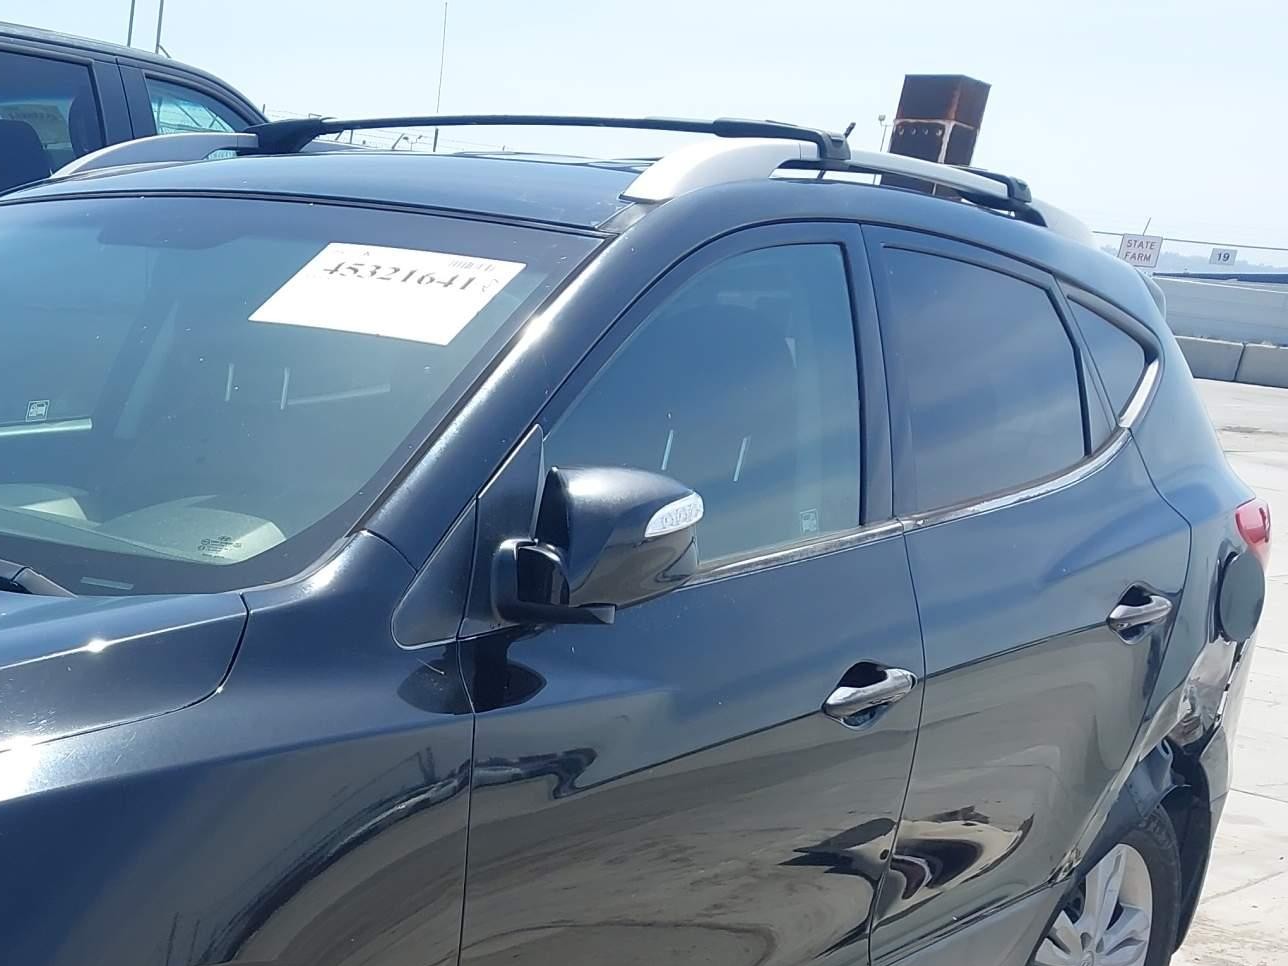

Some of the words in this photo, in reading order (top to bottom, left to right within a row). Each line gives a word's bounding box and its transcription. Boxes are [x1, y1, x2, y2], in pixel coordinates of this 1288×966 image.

[1126, 239, 1156, 250] STATE
[1123, 251, 1152, 262] FARM
[1217, 252, 1230, 262] 19
[323, 261, 476, 290] 45321641
